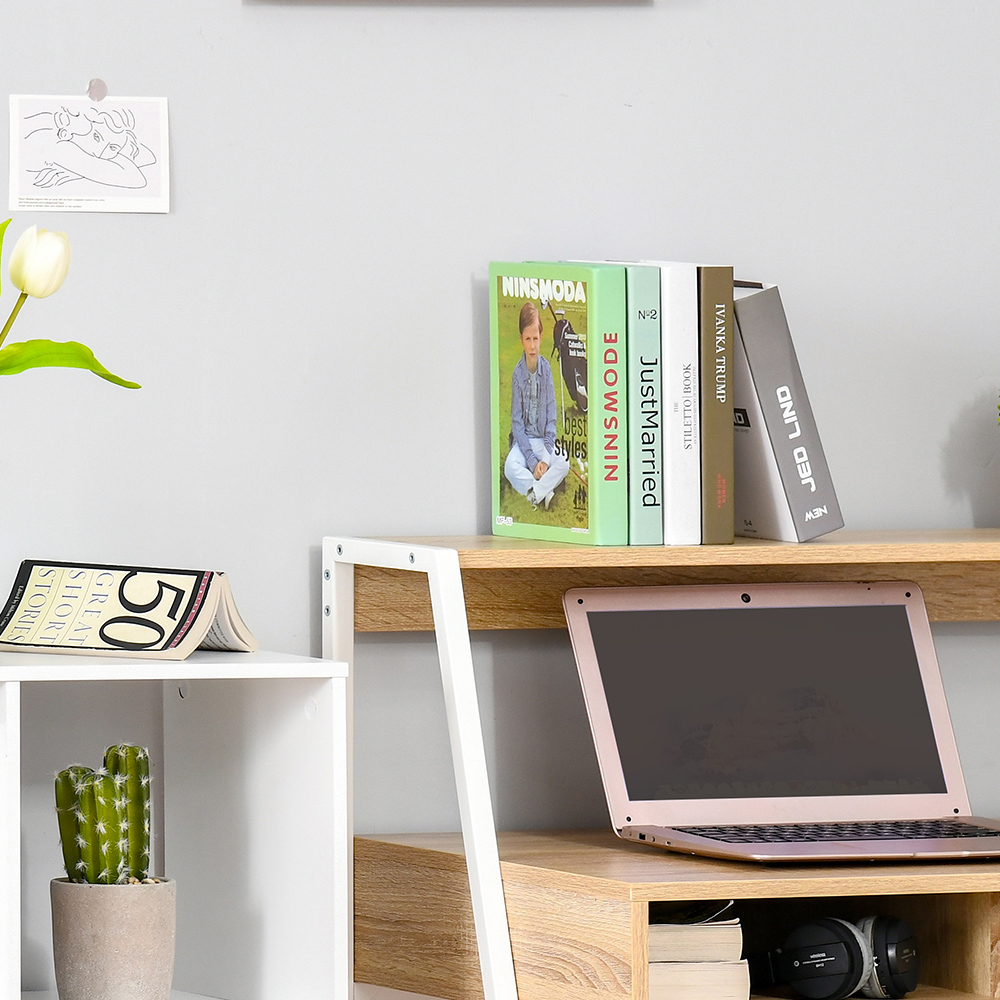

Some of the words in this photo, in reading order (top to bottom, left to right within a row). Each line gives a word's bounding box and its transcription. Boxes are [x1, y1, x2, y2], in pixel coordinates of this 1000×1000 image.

[502, 275, 586, 303] NINSMODA
[715, 303, 726, 353] IVANKA
[682, 363, 692, 394] BOOK
[716, 356, 726, 404] TRUMP
[564, 412, 587, 437] best
[603, 332, 619, 482] NINSMODE
[639, 355, 661, 508] JustMarried
[682, 399, 692, 450] STILETTO
[776, 385, 802, 440] LIND
[554, 435, 587, 461] styles
[793, 446, 817, 492] JED
[804, 505, 829, 522] NEW
[7, 567, 56, 643] STORIES
[47, 569, 88, 644] SHORT
[68, 572, 115, 646] GREAT
[98, 570, 186, 650] 50
